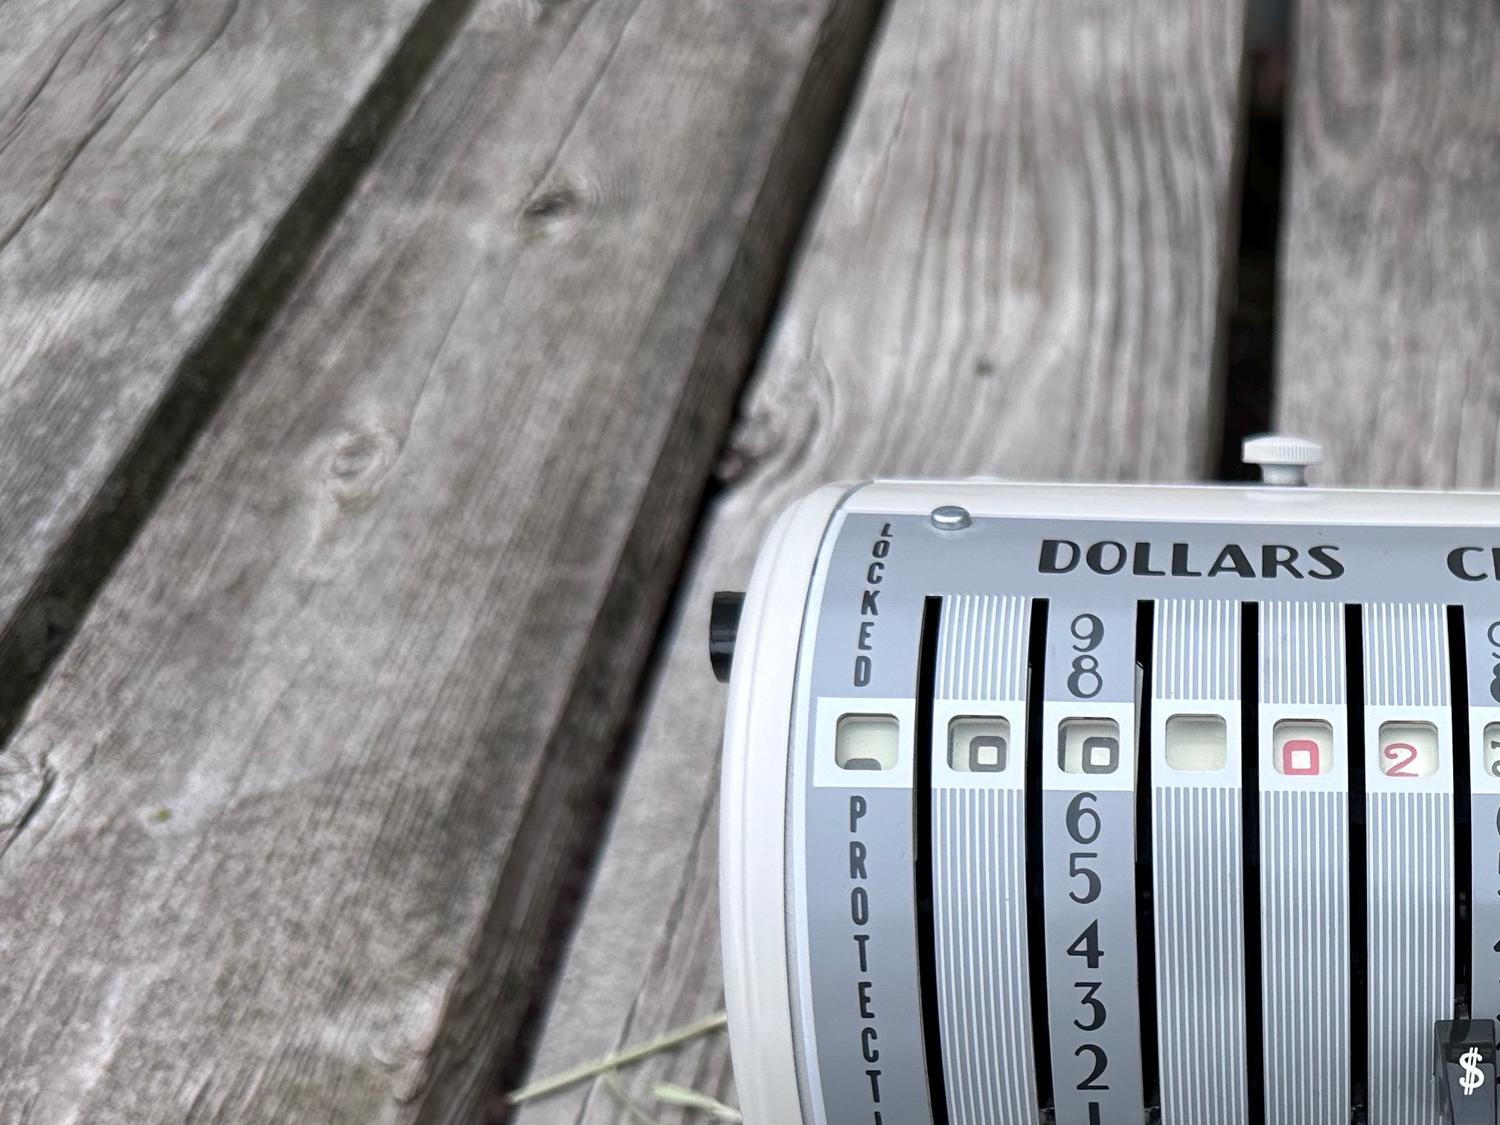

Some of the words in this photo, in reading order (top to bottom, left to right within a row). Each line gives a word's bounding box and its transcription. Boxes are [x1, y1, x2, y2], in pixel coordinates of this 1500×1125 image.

[1038, 539, 1345, 579] DOLLARS
[853, 523, 893, 687] LOCKED
[1071, 613, 1105, 652] 9
[1067, 655, 1103, 698] 8
[1383, 743, 1419, 777] 2
[1066, 792, 1101, 844] 6
[1069, 852, 1101, 904] 5
[1066, 919, 1104, 969] 4
[1073, 982, 1107, 1031] 3
[1074, 1044, 1109, 1090] 2
[1459, 1046, 1485, 1095] $
